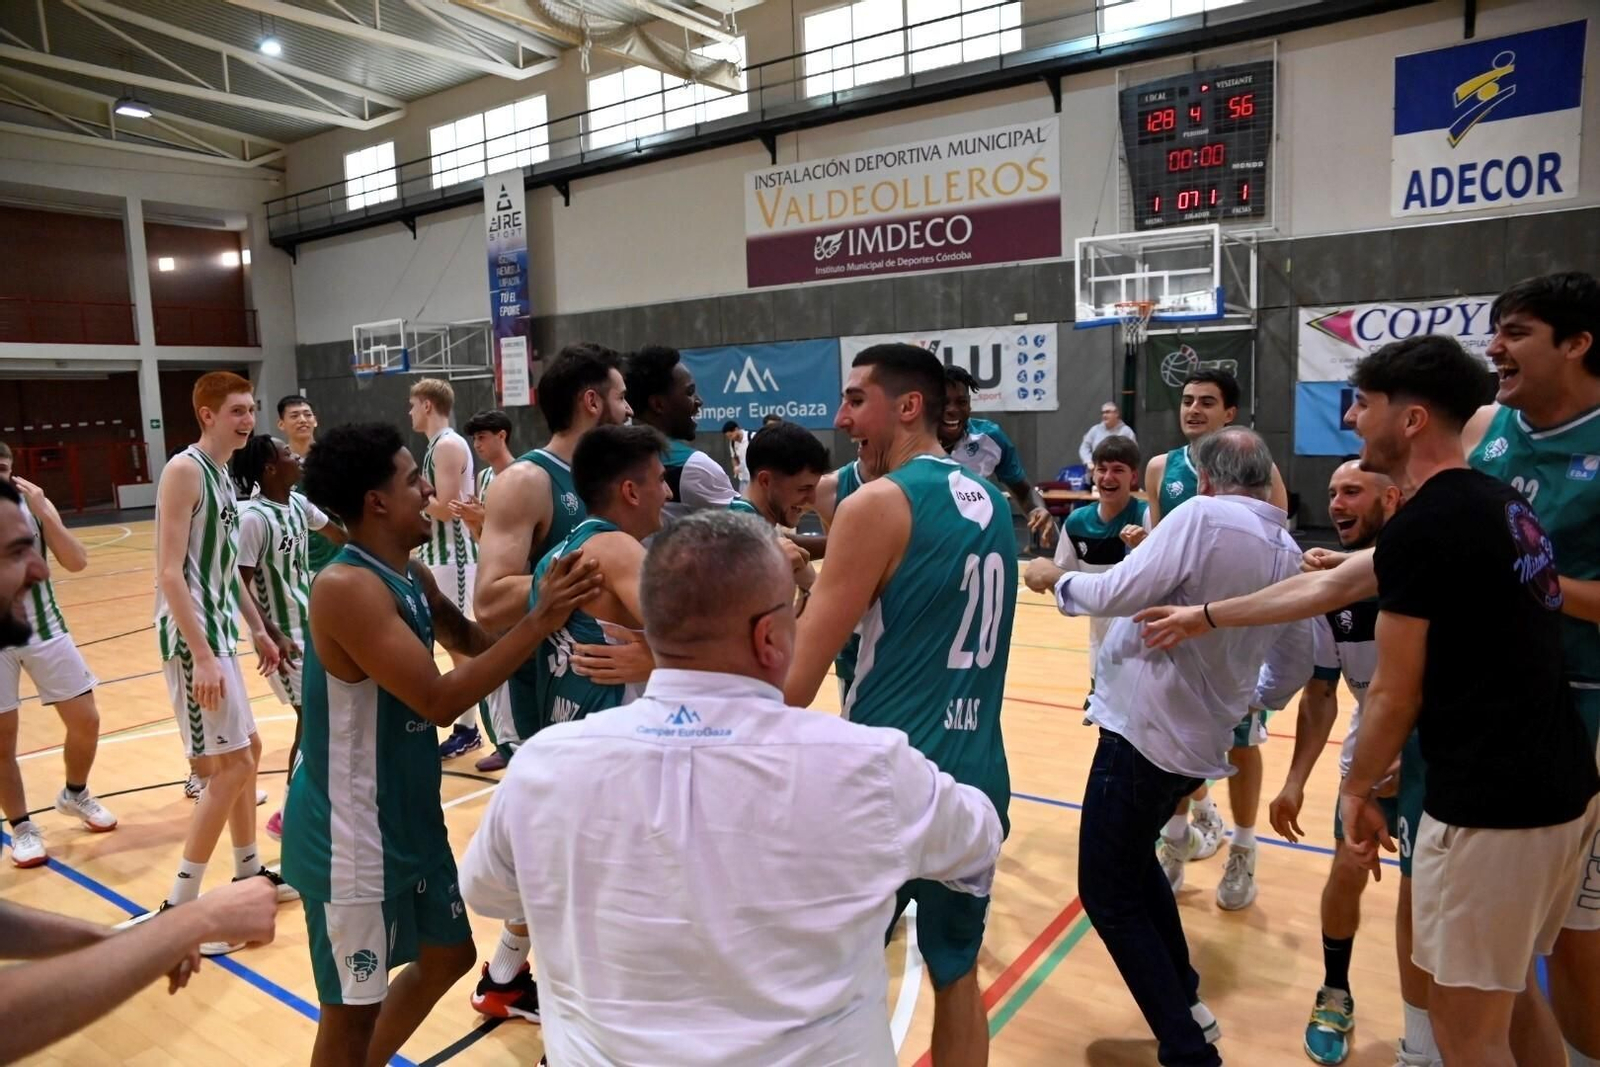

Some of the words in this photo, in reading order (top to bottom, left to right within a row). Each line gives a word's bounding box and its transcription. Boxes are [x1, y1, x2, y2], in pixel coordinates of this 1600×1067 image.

[1216, 75, 1253, 88] VISITANTE
[1190, 106, 1201, 122] 4
[1229, 95, 1254, 118] 56
[1147, 109, 1175, 132] 128
[754, 158, 850, 190] INSTALACIÓN
[855, 145, 942, 173] DEPORTIVA
[947, 126, 1047, 157] MUNICIPAL
[1169, 144, 1225, 171] 00:00
[1232, 161, 1264, 169] MONDO
[756, 157, 1050, 228] VALDEOLLEROS
[1403, 151, 1563, 210] ADECOR
[848, 214, 972, 256] IMDECO
[815, 266, 845, 275] Instituto
[847, 260, 884, 271] Municipal
[885, 259, 896, 268] de
[897, 255, 935, 267] Deportes
[936, 251, 972, 262] Córdoba
[1356, 303, 1496, 341] COPY
[695, 405, 742, 421] amper
[749, 401, 828, 418] EuroGaza
[947, 552, 1005, 669] 20
[636, 725, 676, 738] Camper
[678, 726, 733, 738] EuroGaza
